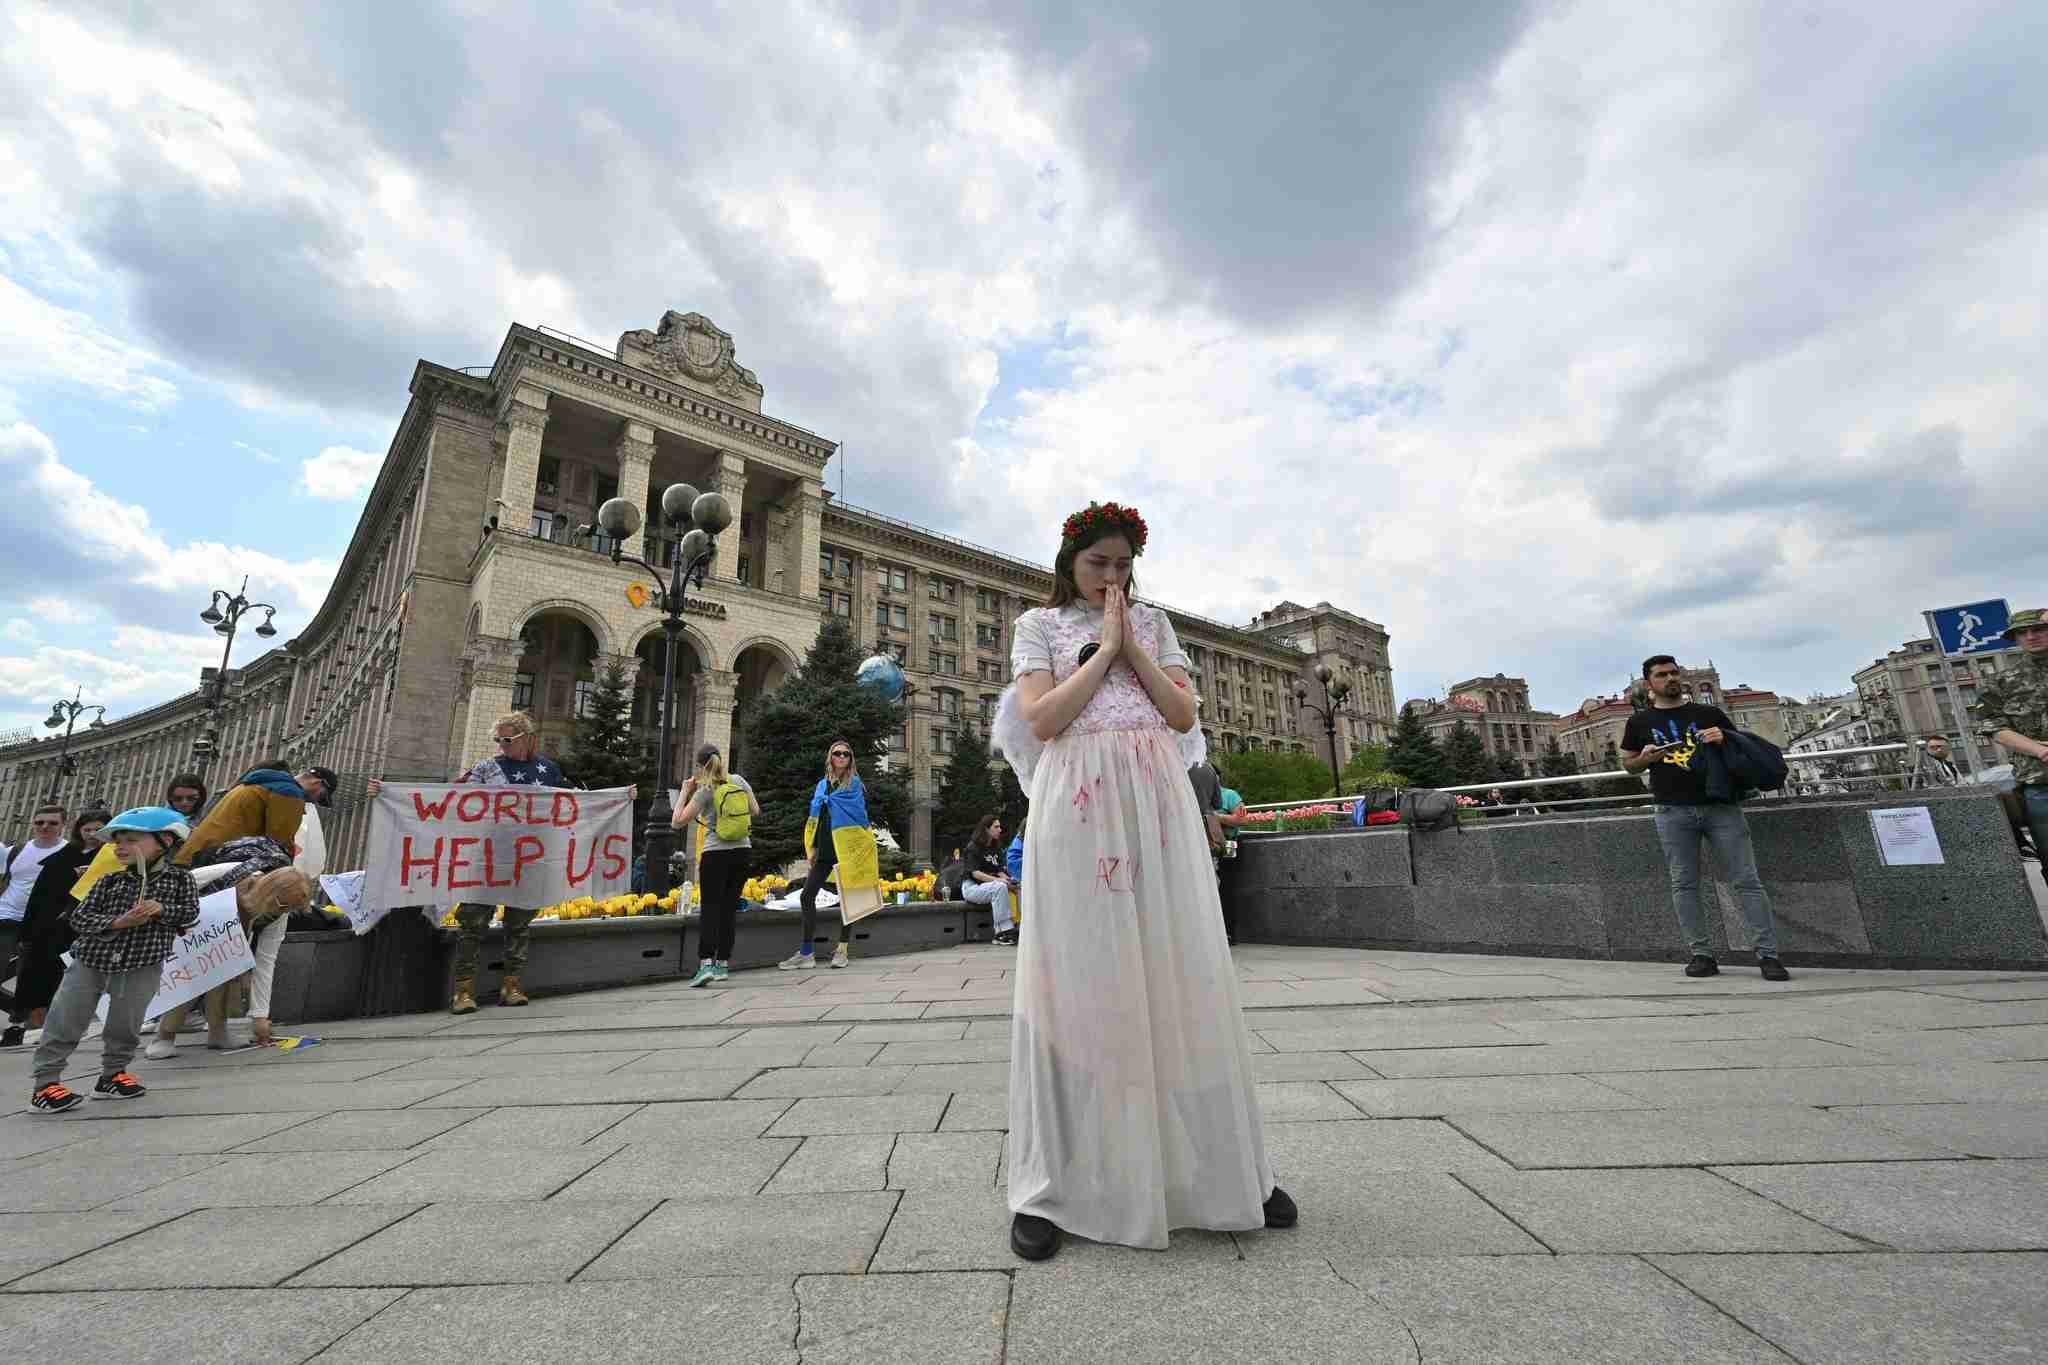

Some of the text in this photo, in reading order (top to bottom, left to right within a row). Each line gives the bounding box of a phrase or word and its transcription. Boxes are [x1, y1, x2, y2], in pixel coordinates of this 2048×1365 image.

[410, 790, 579, 827] WORLD
[400, 834, 628, 890] HELP US
